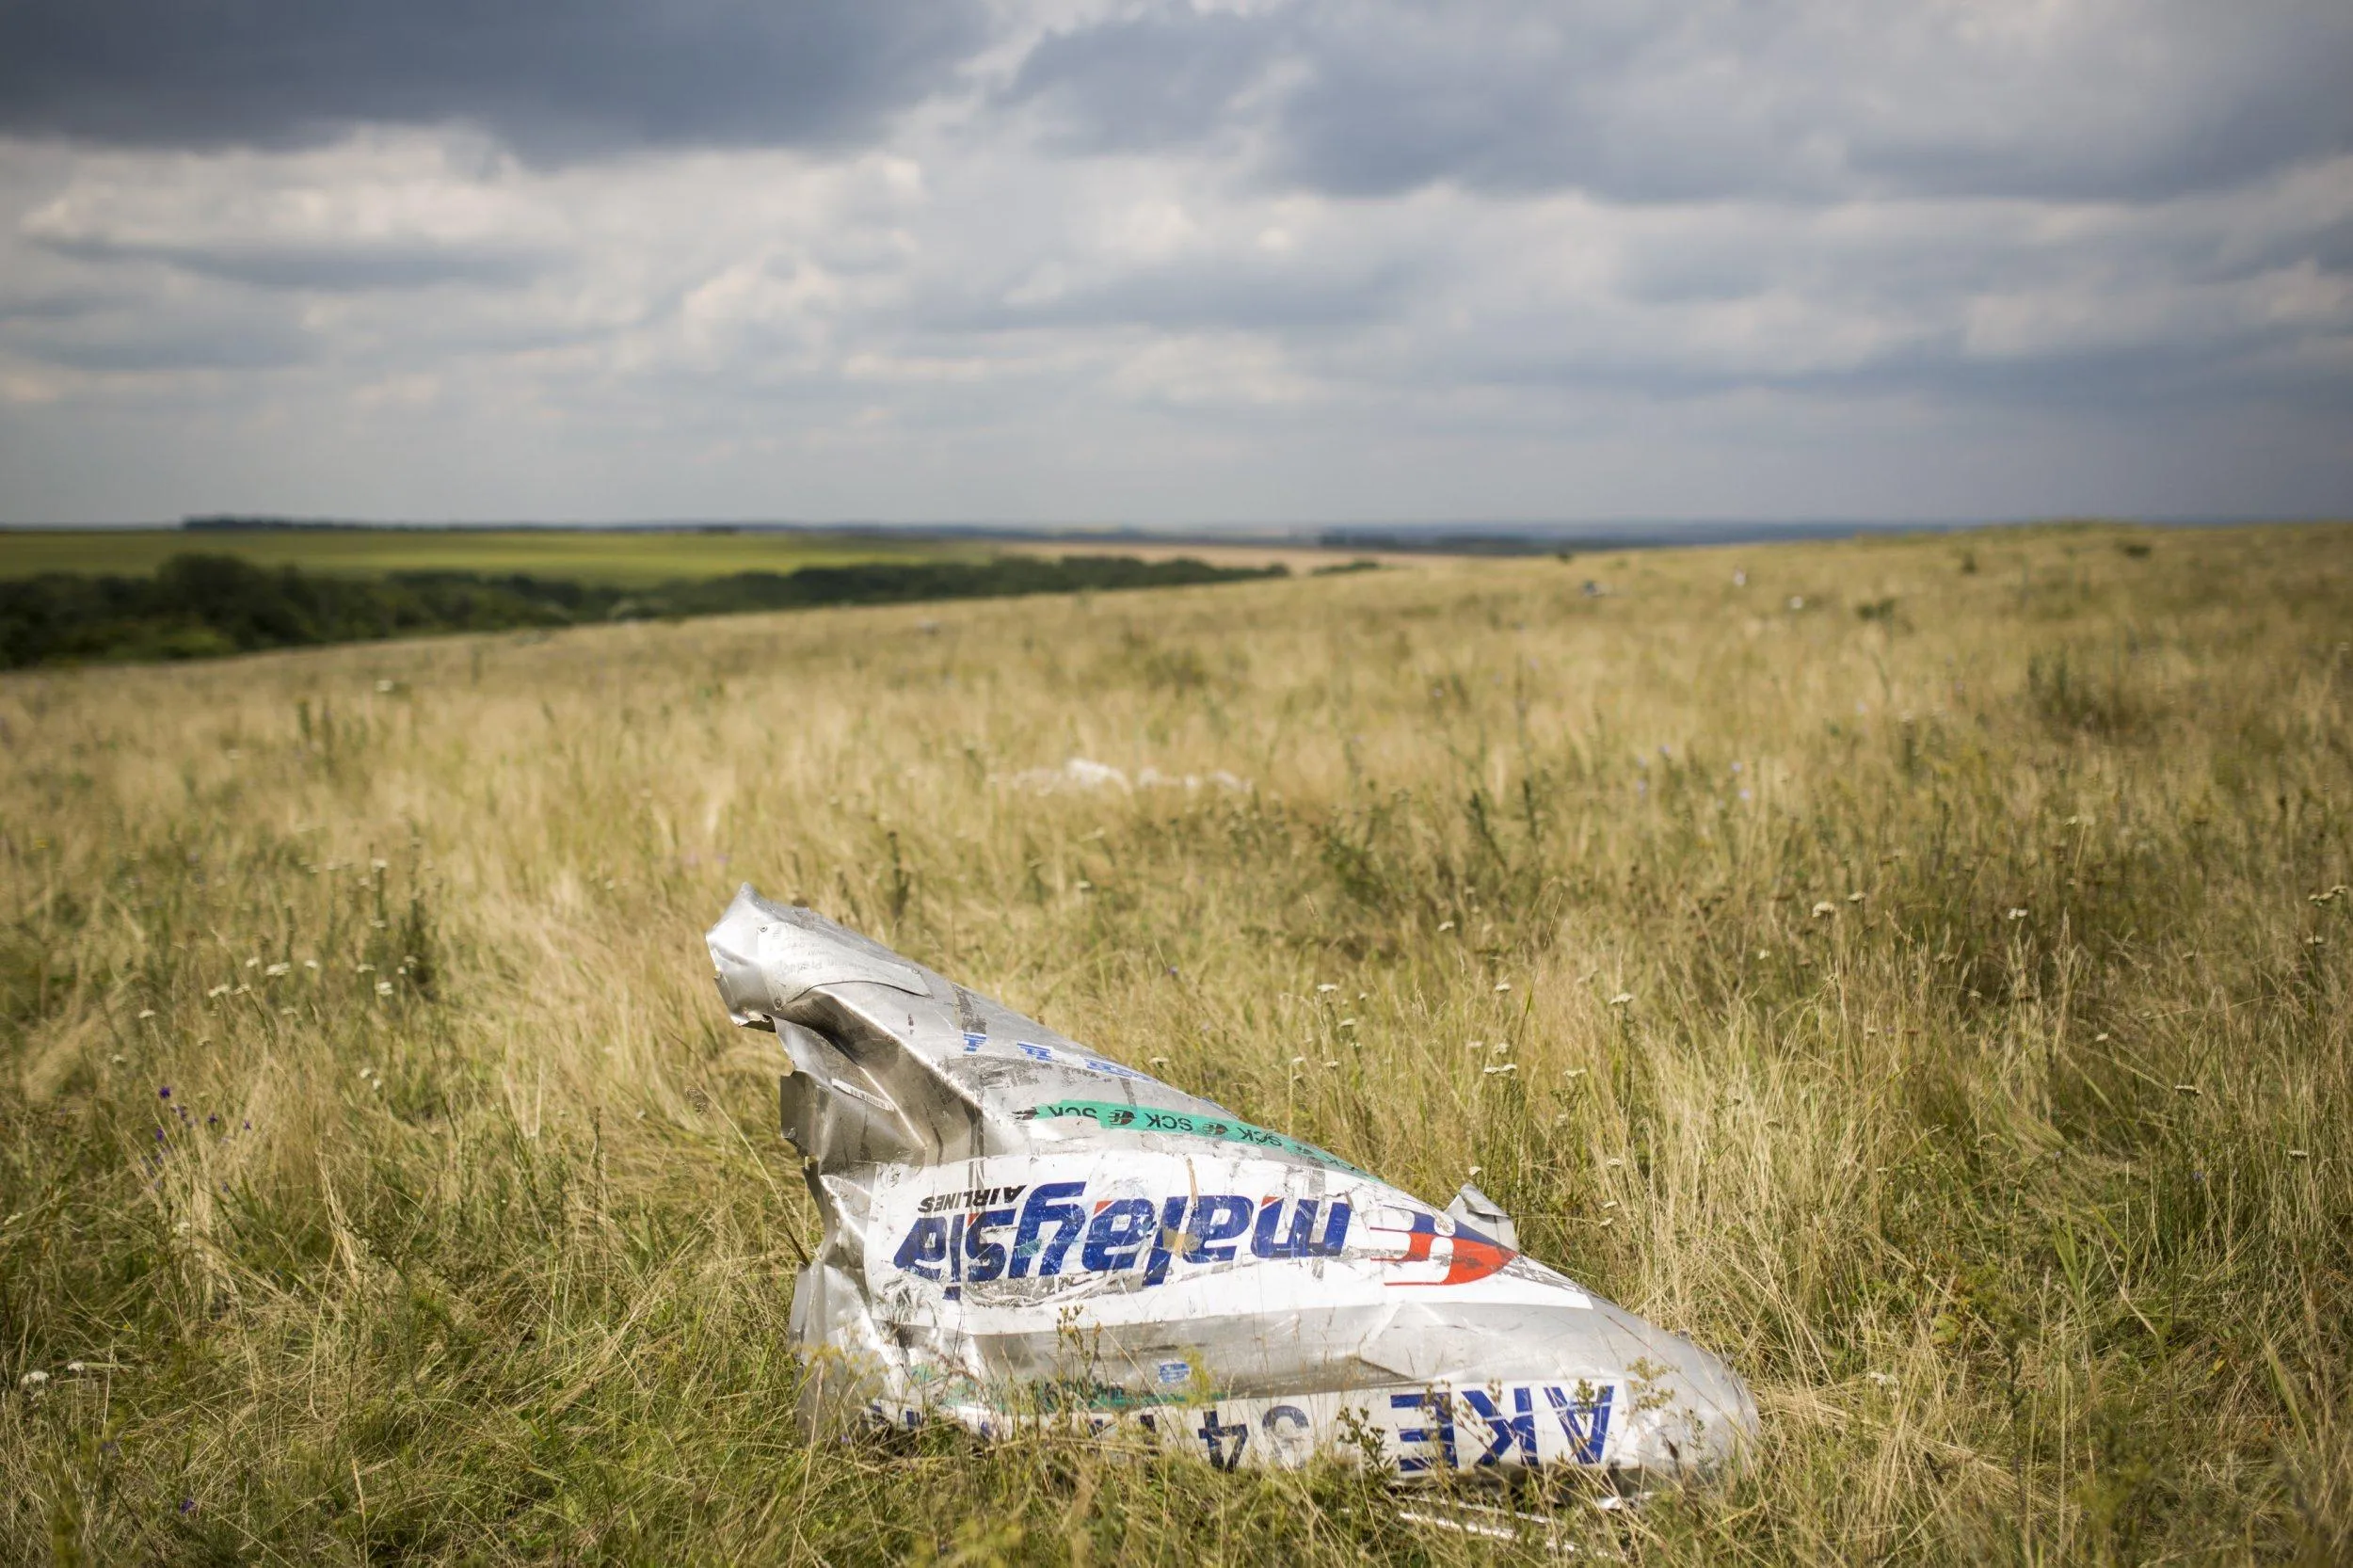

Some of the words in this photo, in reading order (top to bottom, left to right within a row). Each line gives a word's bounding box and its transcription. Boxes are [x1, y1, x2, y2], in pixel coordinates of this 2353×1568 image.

[1144, 1112, 1193, 1133] SCK
[1237, 1126, 1284, 1147] SCK
[917, 1184, 1027, 1214] AIRLINES
[1389, 1384, 1615, 1474] AKE
